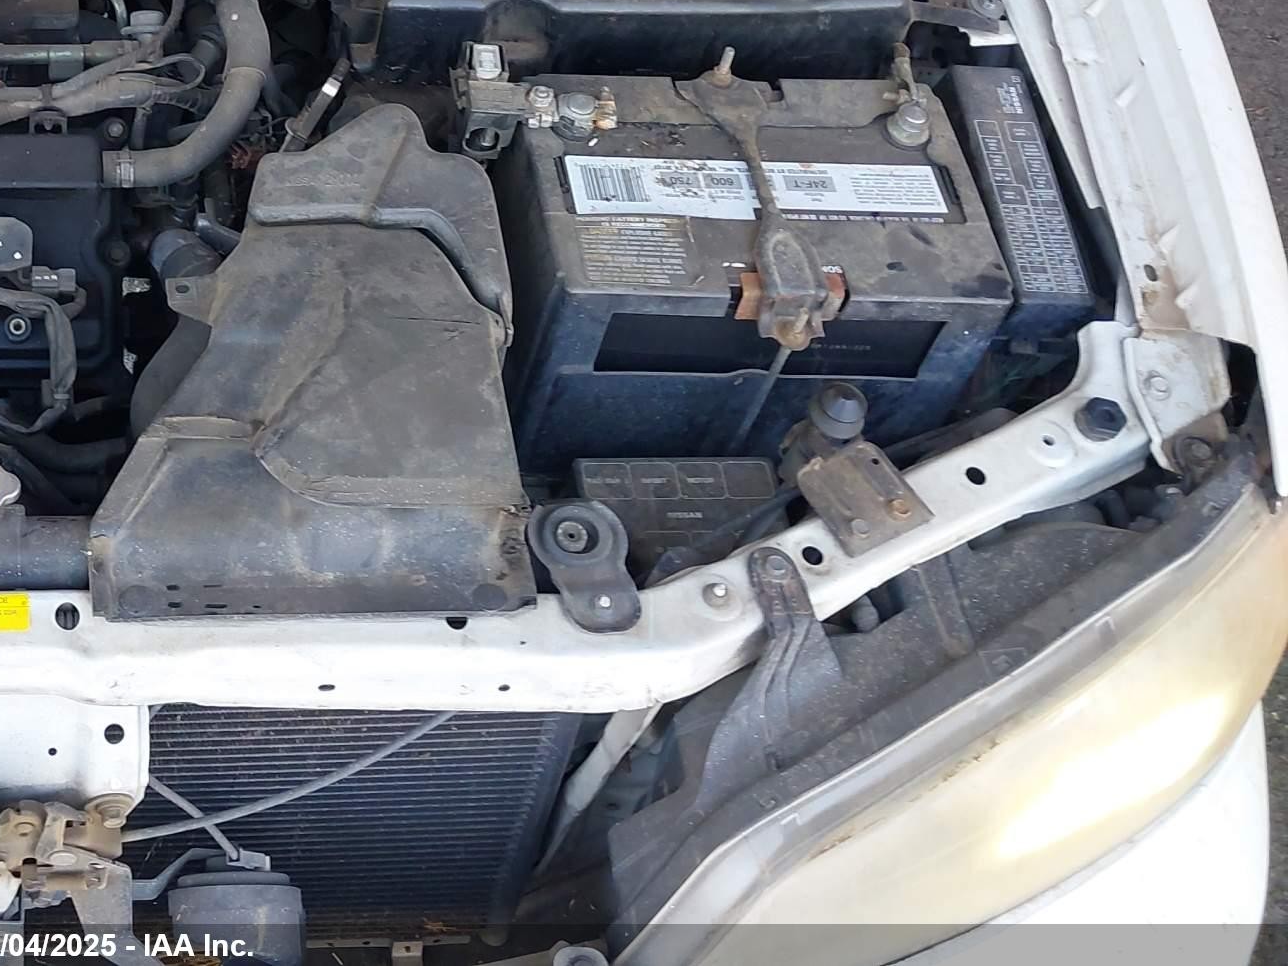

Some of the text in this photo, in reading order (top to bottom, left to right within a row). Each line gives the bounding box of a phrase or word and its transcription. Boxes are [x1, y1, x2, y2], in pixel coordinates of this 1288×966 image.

[671, 176, 693, 185] 750
[711, 177, 734, 186] 600
[793, 179, 829, 189] 24F-T
